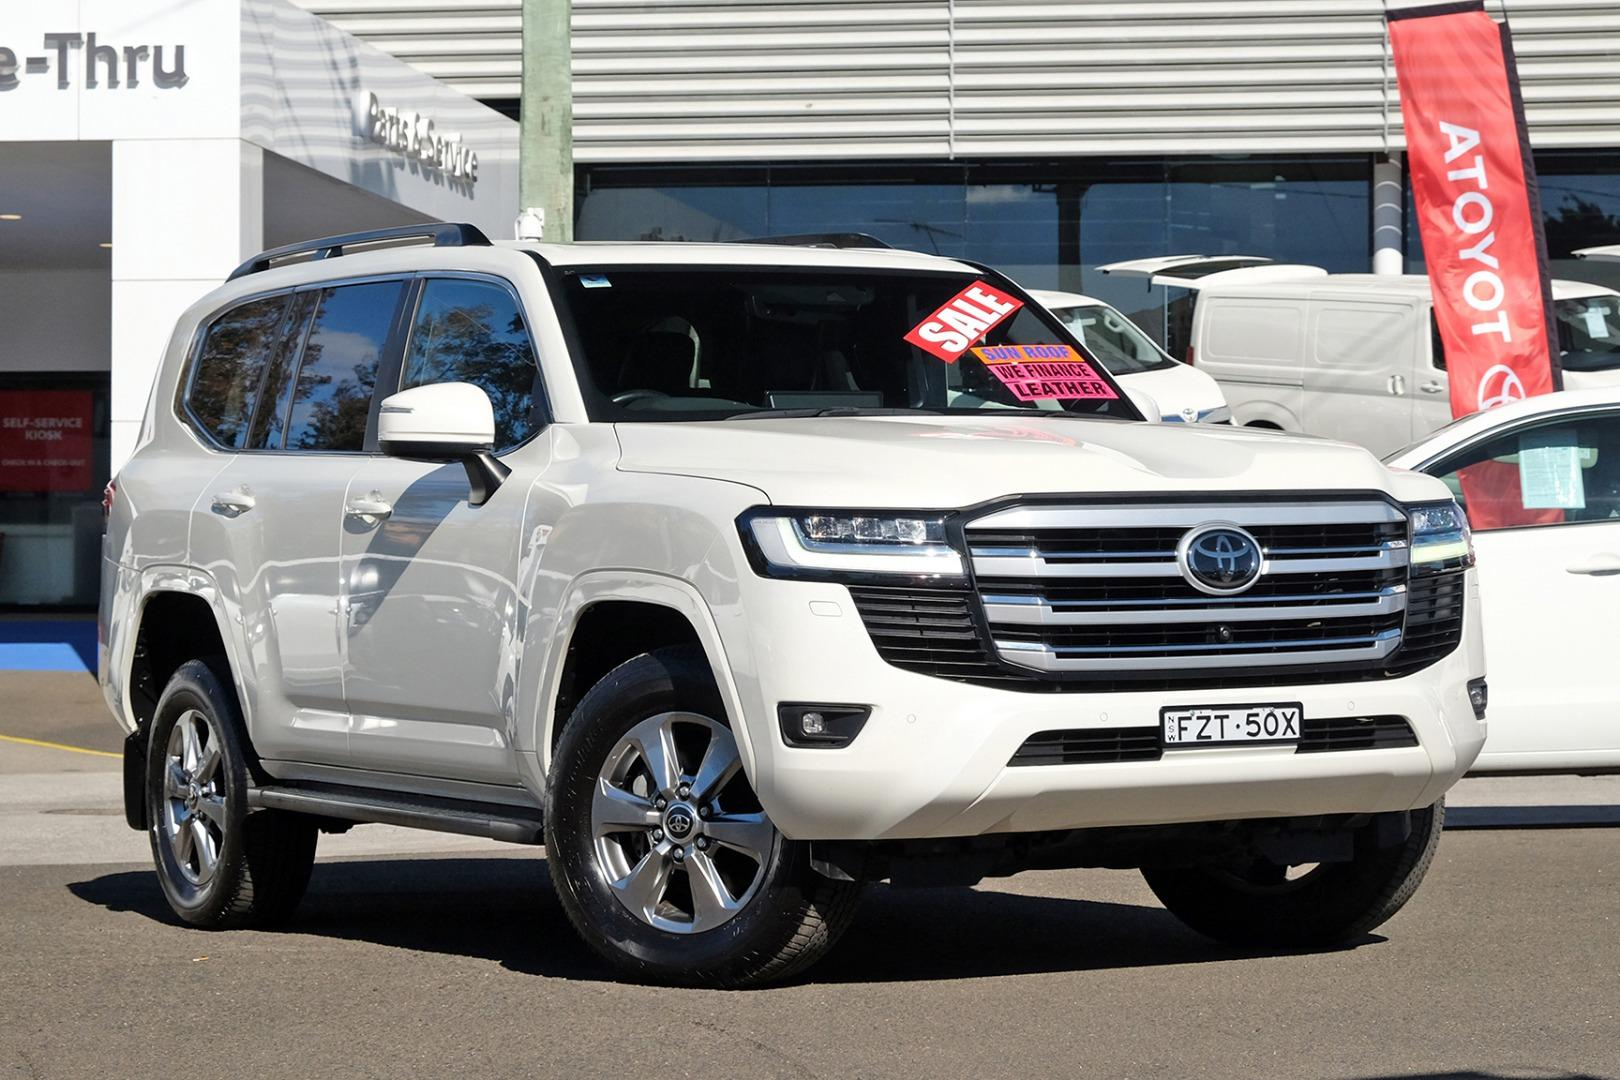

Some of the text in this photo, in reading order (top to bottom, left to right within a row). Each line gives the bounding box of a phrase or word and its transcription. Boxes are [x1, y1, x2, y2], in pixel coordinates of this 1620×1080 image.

[420, 118, 478, 183] Service
[917, 286, 1016, 354] SALE
[980, 344, 1070, 362] SUN ROOF
[995, 363, 1091, 380] WE FINANCE
[1014, 381, 1107, 398] LEATHER
[3, 417, 82, 428] SELF-SERVICE
[25, 430, 62, 440] KIOSK
